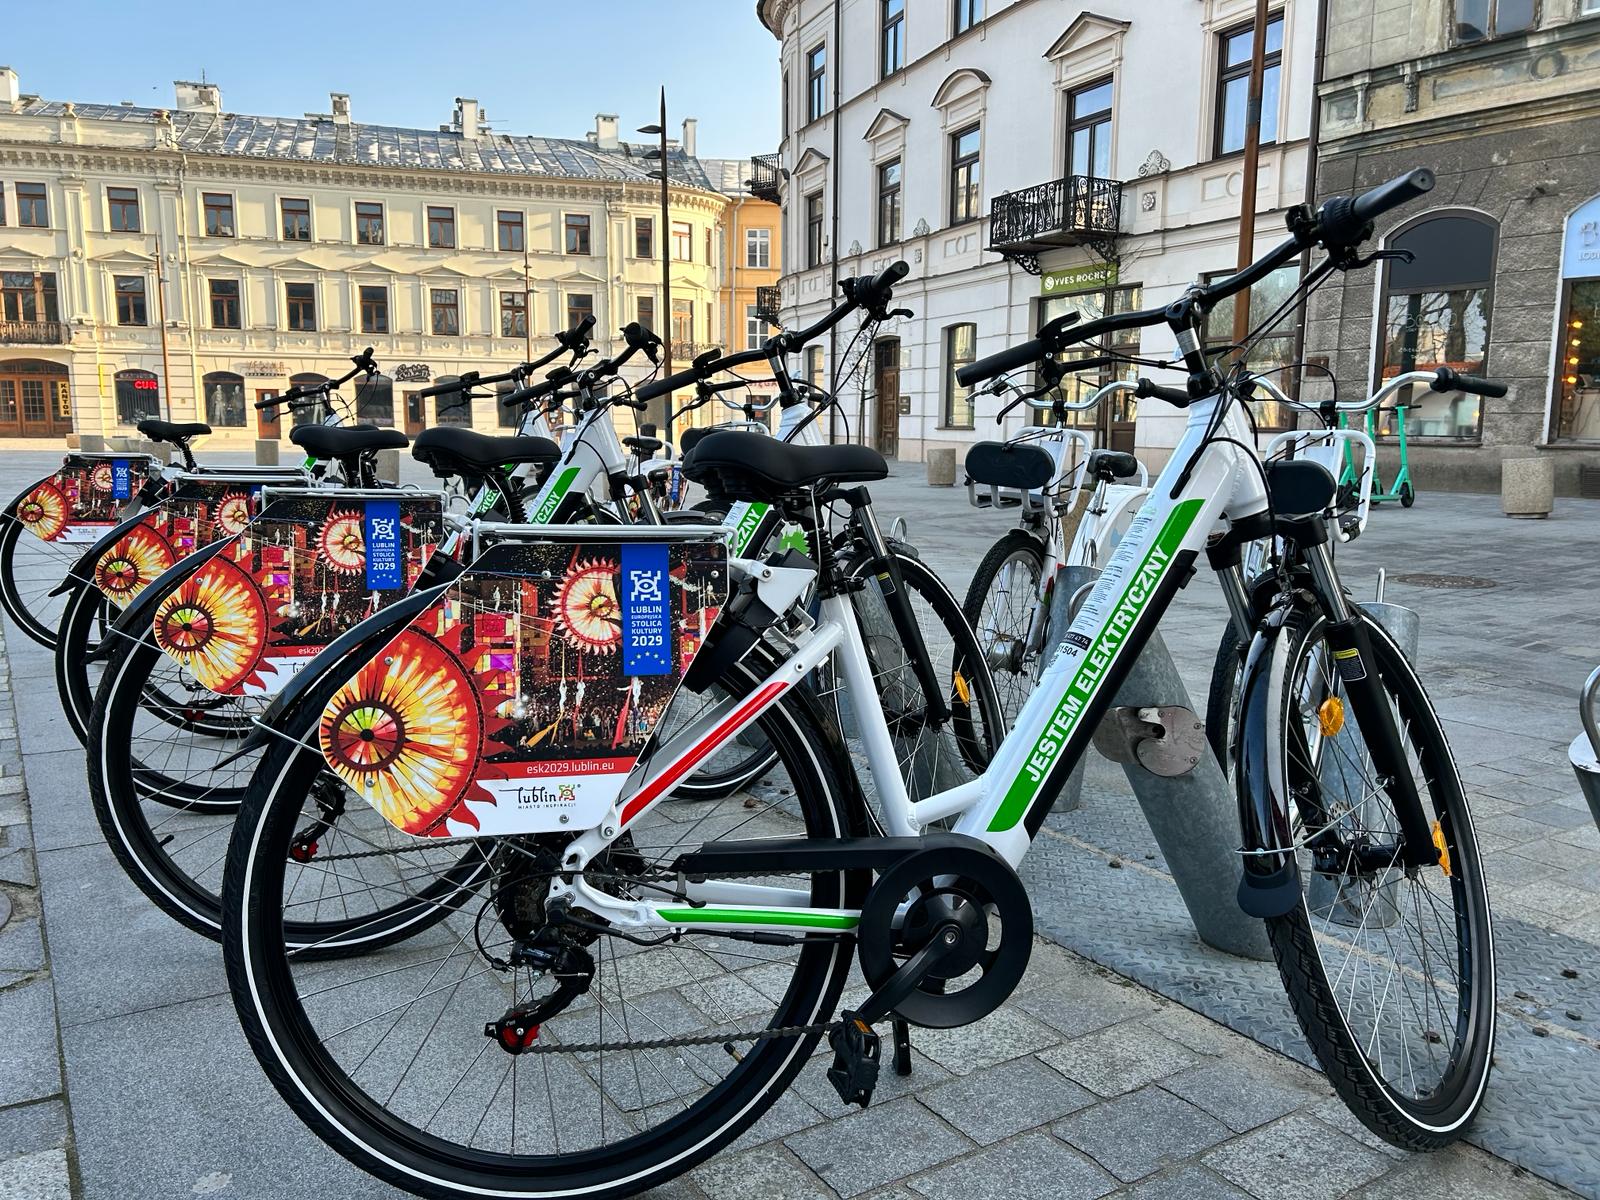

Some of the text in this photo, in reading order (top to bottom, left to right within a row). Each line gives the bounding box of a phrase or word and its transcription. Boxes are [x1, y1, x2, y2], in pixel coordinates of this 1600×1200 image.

[1054, 275, 1075, 286] YVES
[60, 383, 70, 415] KANTOR
[372, 562, 396, 570] 2029
[631, 605, 662, 614] LUBLIN
[631, 620, 662, 628] STOLICA
[631, 635, 663, 647] 2029
[1024, 697, 1083, 783] JESTEM
[1075, 544, 1170, 696] ELEKTRYCZNY
[526, 761, 615, 774] esk2029.lublin.eu
